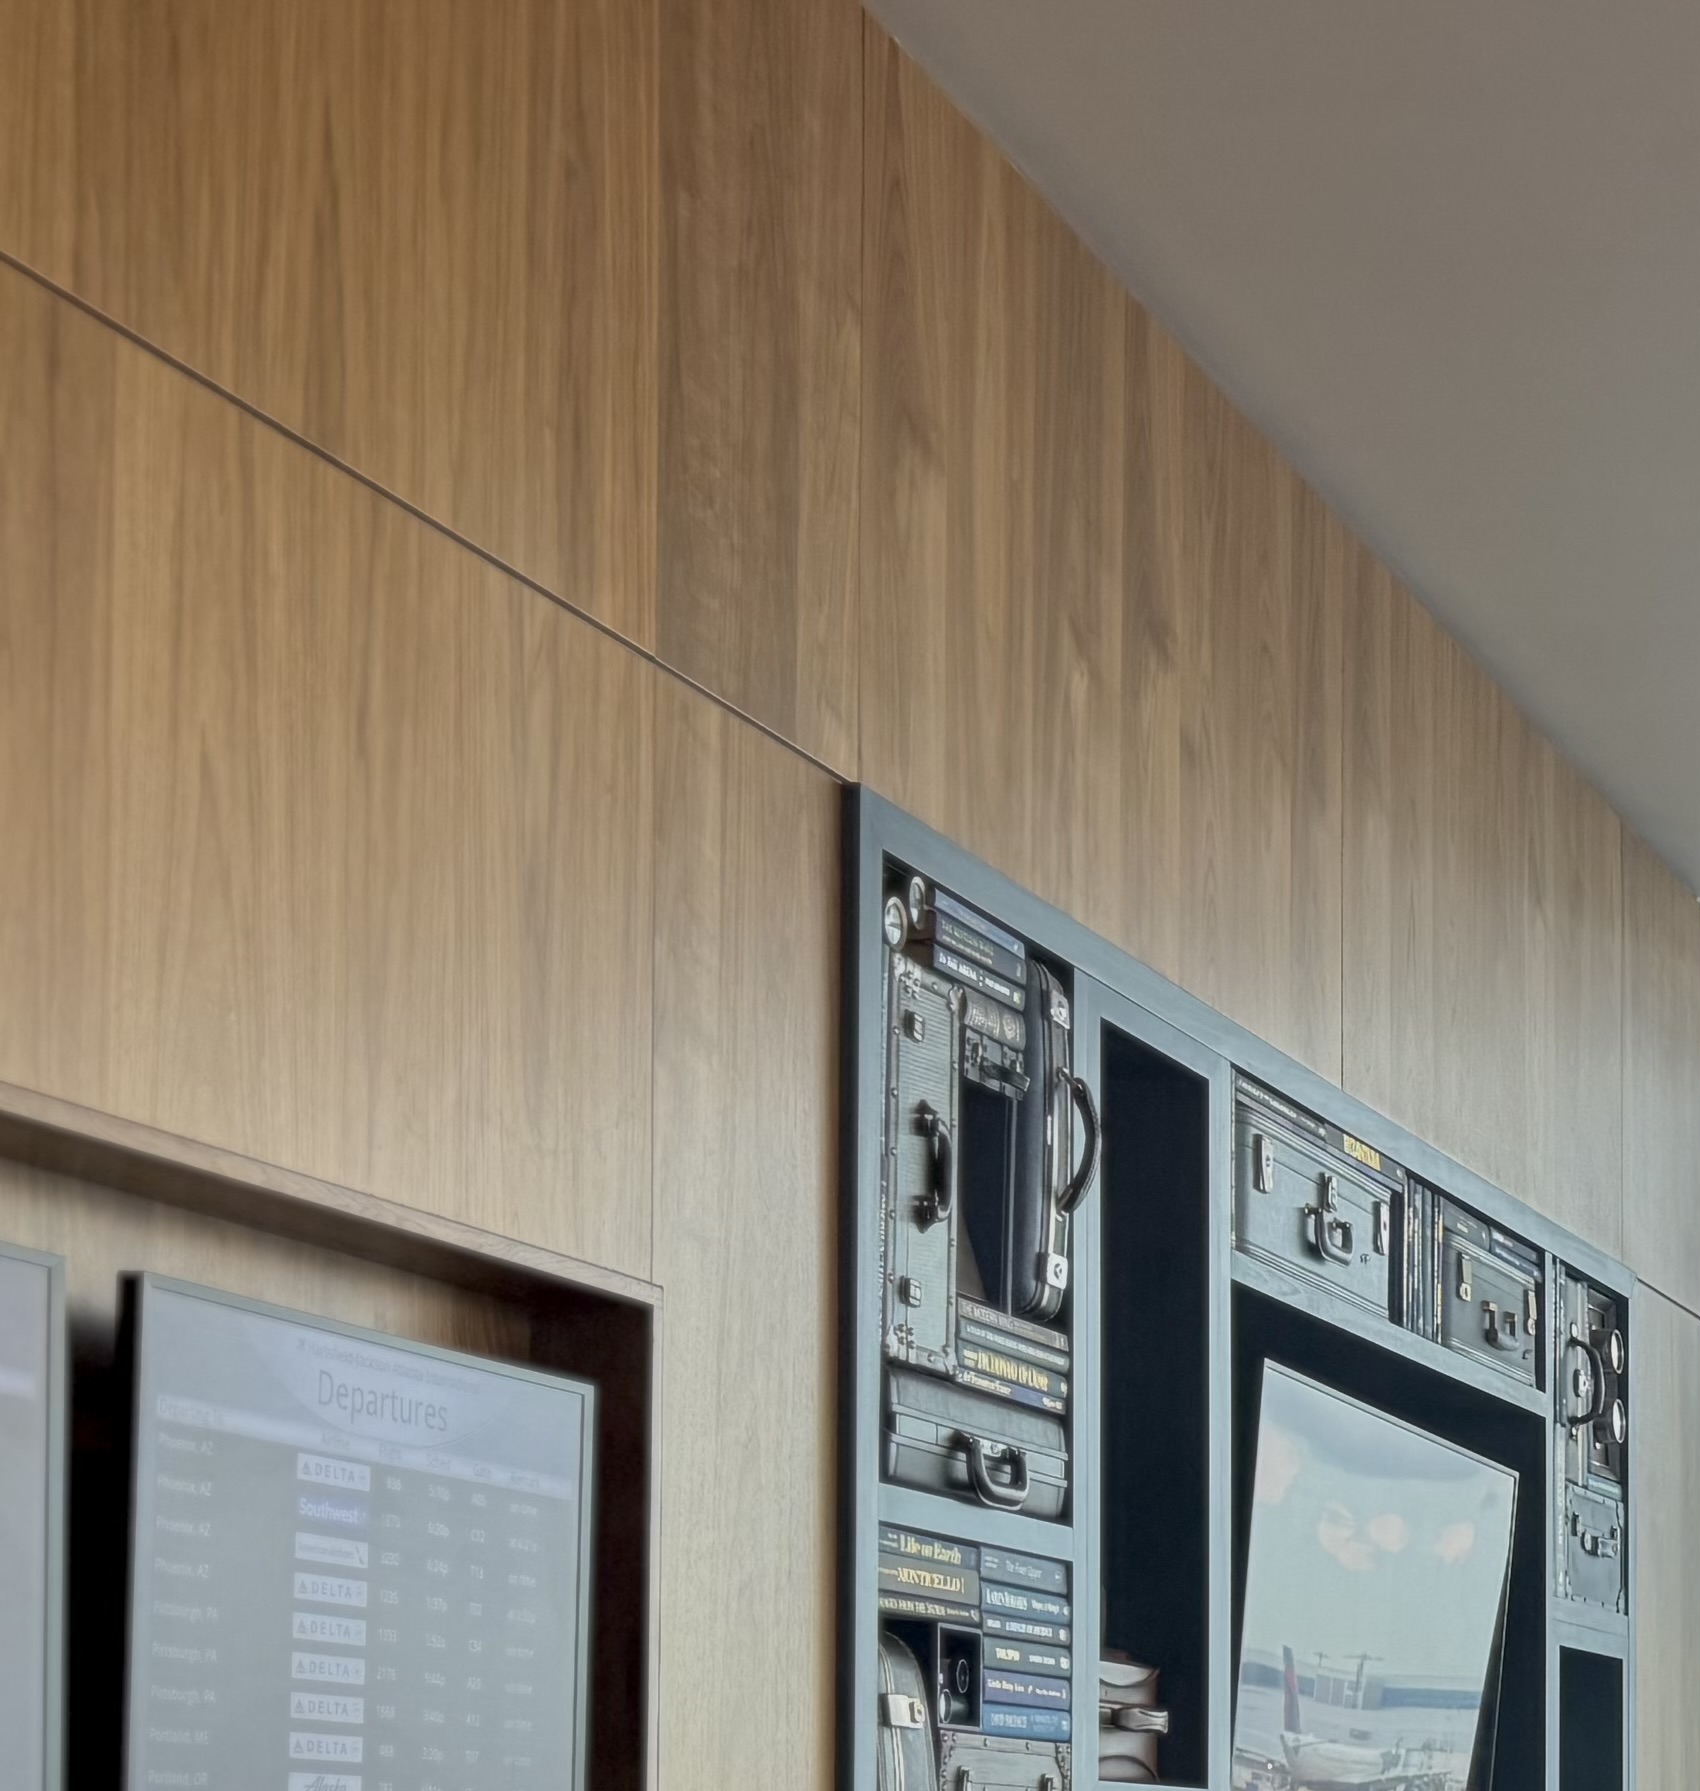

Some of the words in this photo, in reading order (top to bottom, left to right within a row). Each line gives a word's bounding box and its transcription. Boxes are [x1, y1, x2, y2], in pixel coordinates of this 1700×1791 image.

[318, 1368, 449, 1433] Departures
[313, 1461, 356, 1484] DELTA
[299, 1497, 359, 1525] Southwest
[899, 1534, 922, 1555] Life
[933, 1542, 962, 1565] Earth
[310, 1580, 352, 1600] DELTA
[309, 1619, 351, 1639] DELTA
[308, 1659, 350, 1678] DELTA
[307, 1699, 349, 1717] DELTA
[305, 1738, 348, 1756] DELTA
